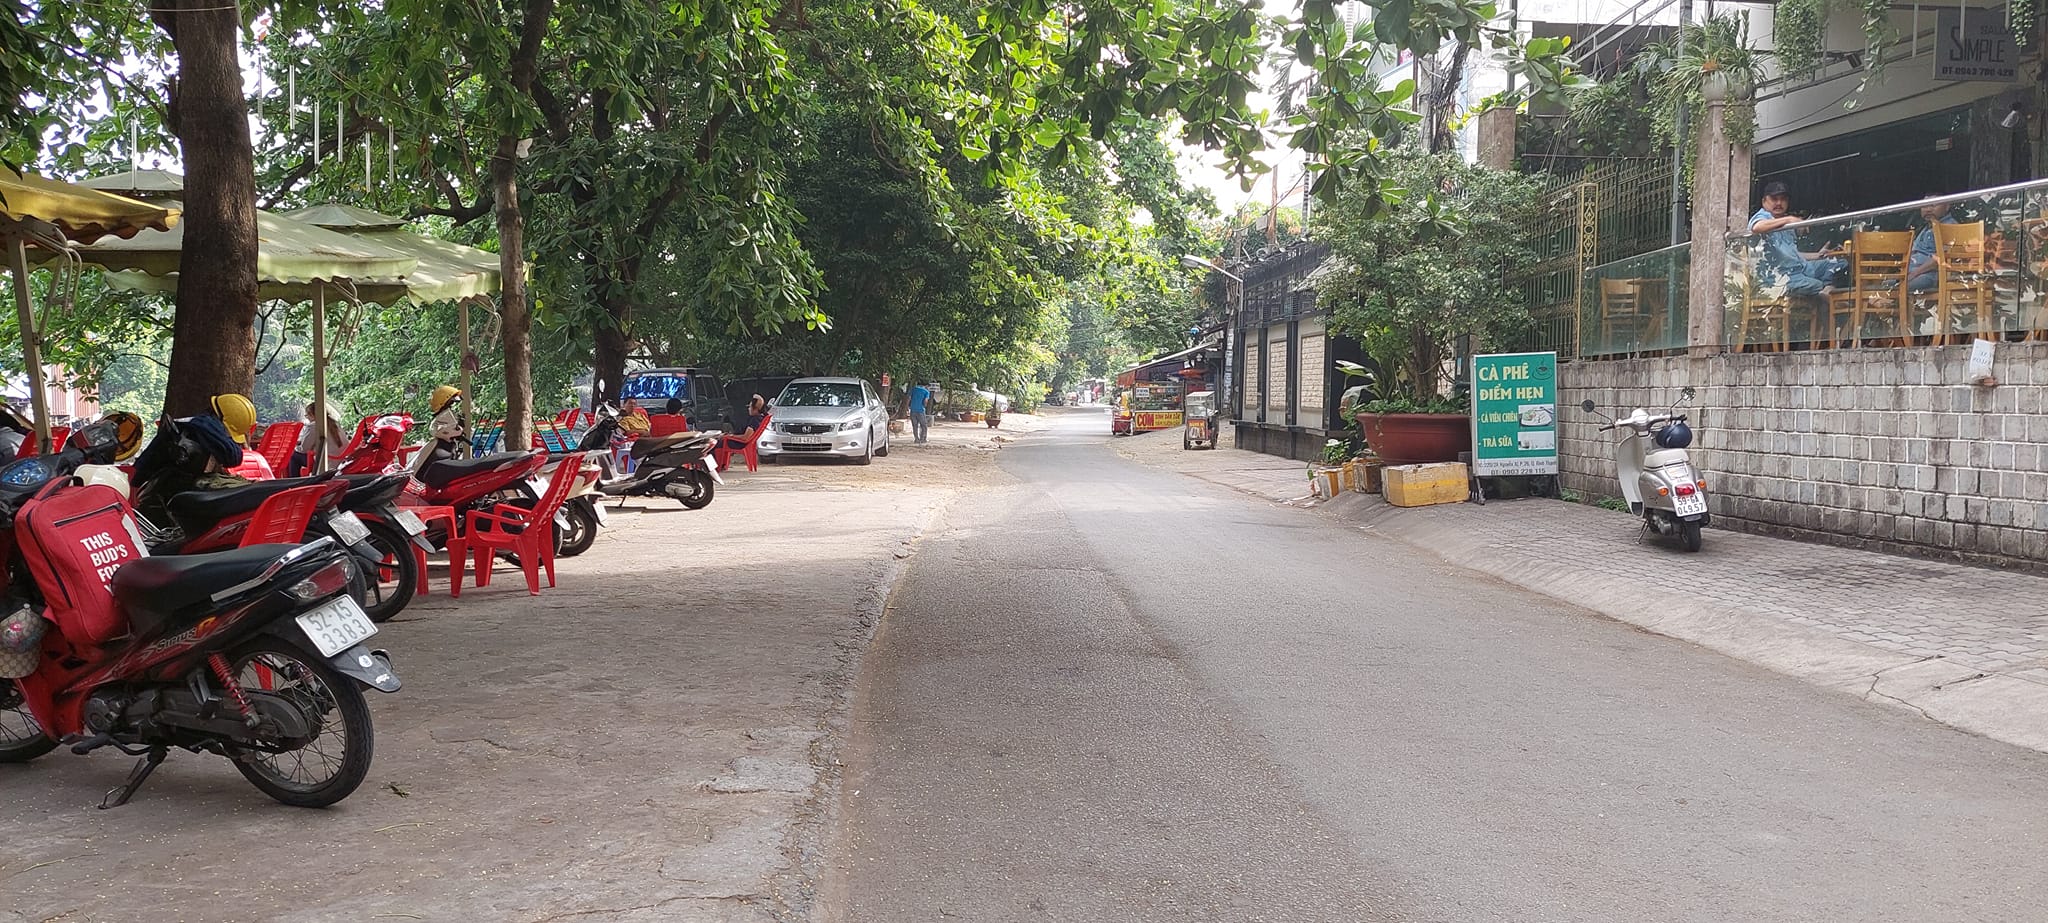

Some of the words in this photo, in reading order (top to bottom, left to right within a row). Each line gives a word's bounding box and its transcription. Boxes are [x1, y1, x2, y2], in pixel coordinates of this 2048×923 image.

[1949, 25, 2006, 63] SIMPLE
[1478, 363, 1499, 382] CÀ
[1503, 362, 1530, 381] PHÊ
[1479, 383, 1513, 401] ĐIỂM
[1516, 386, 1544, 402] HẸN
[80, 532, 113, 551] THIS
[90, 544, 128, 567] BUD'S
[322, 619, 367, 649] 3383
